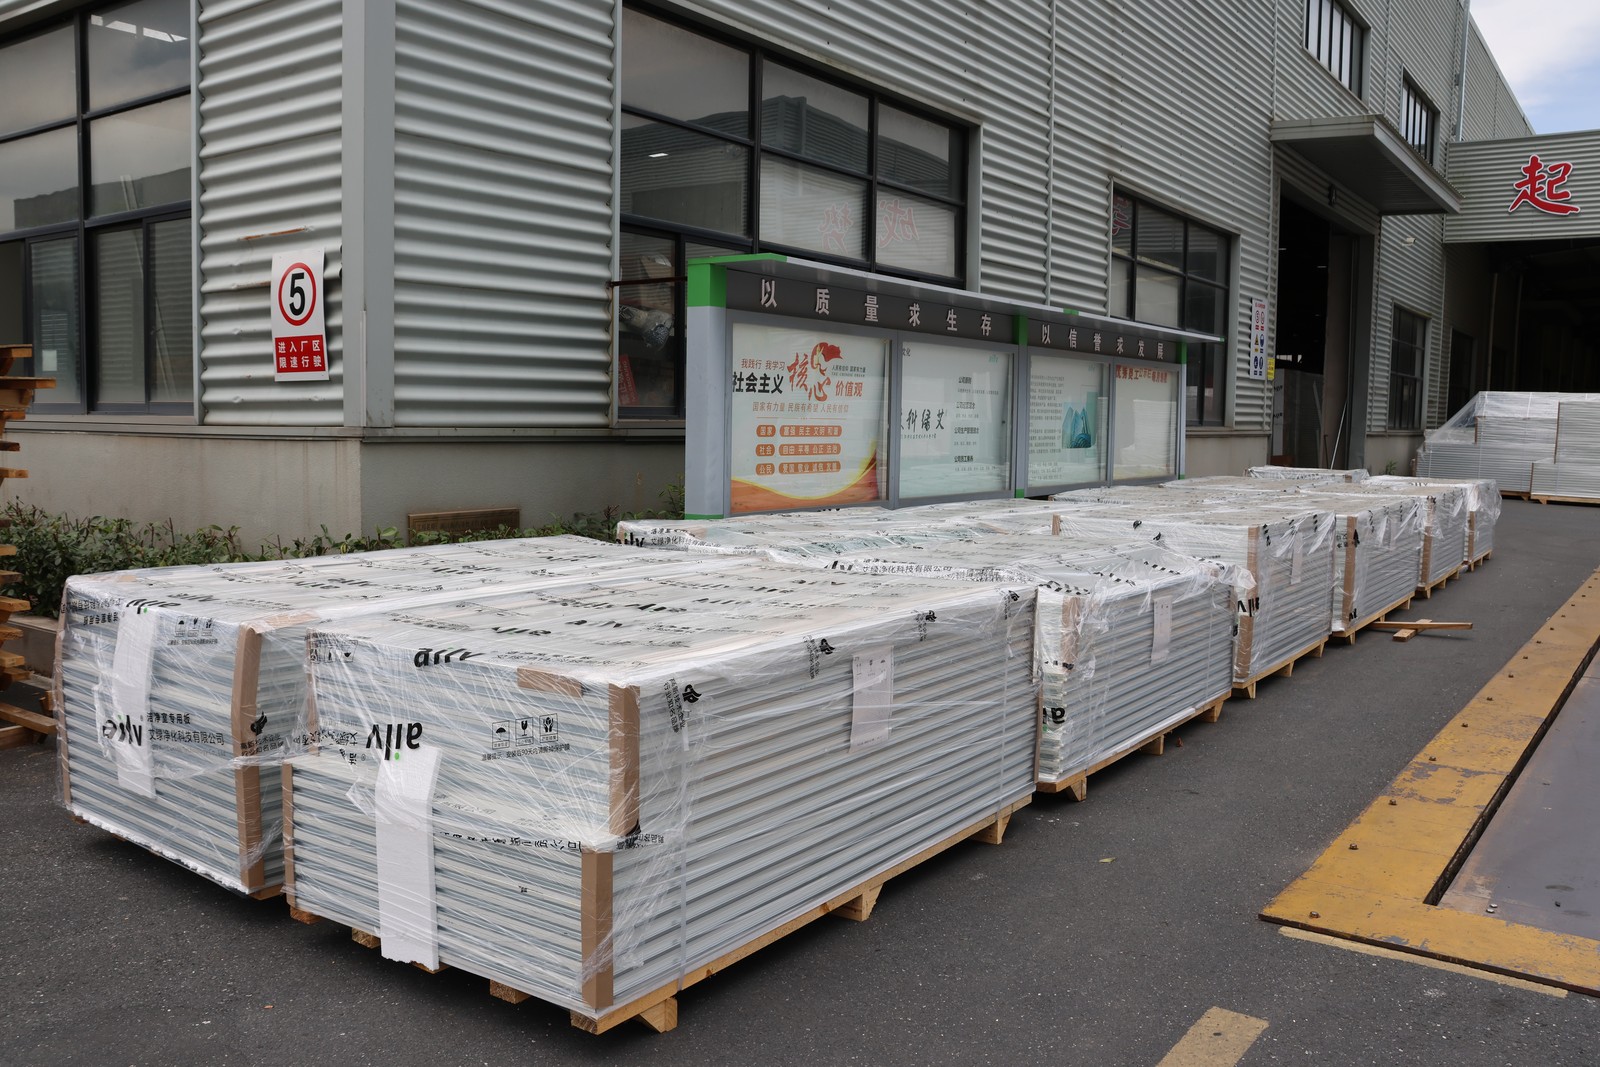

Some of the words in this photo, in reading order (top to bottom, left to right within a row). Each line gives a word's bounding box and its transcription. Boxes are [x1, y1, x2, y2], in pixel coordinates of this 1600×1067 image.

[1508, 154, 1580, 215] 起
[289, 272, 305, 316] 5
[761, 278, 992, 336] 以质量求生存
[278, 339, 321, 354] 进入厂区
[1041, 323, 1164, 360] 以信誉求发展
[279, 355, 322, 368] 限速行驶
[741, 358, 762, 369] 我践行
[765, 360, 786, 371] 我学习
[732, 371, 784, 394] 社会主义
[835, 380, 863, 397] 价值观
[752, 401, 785, 412] 国家有力量
[760, 426, 773, 435] 国家
[798, 426, 810, 436] 民主
[760, 445, 772, 455] 社会
[783, 445, 795, 454] 自由
[760, 465, 773, 474] 公民
